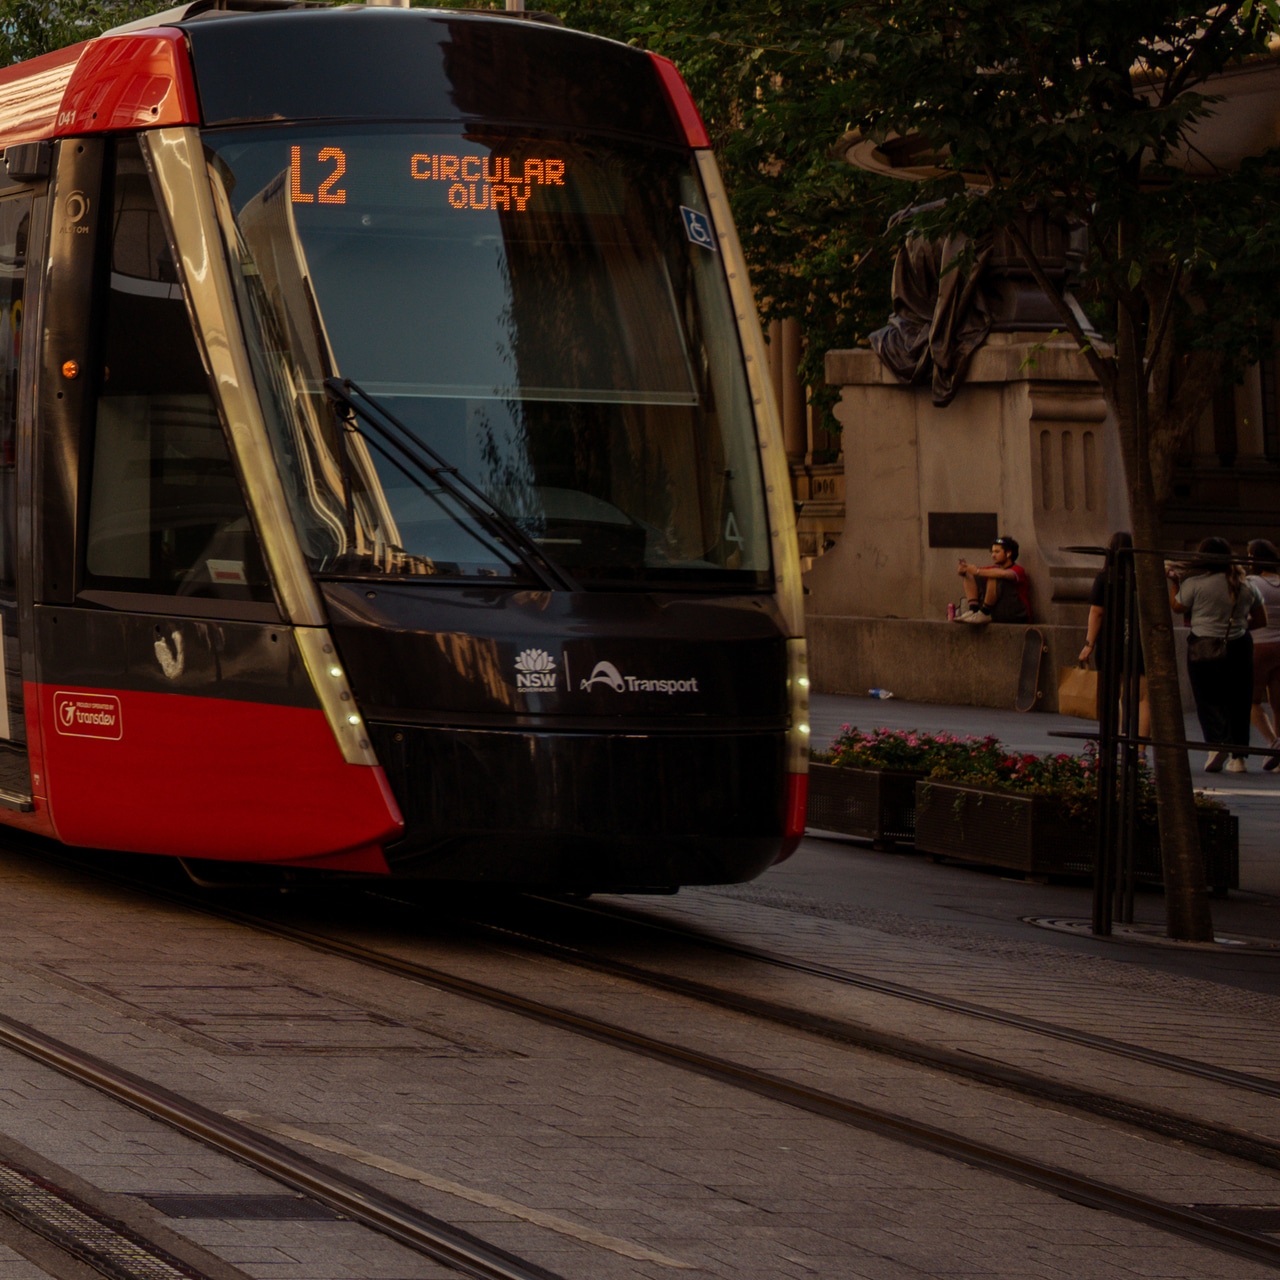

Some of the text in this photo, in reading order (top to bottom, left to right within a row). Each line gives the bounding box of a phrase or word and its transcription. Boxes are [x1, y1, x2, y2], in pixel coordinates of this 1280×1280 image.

[289, 145, 566, 205] L2 CIRCULAR
[448, 183, 532, 212] QUAY
[516, 673, 557, 687] NSW
[624, 676, 699, 695] Transport
[75, 709, 115, 726] transdev
